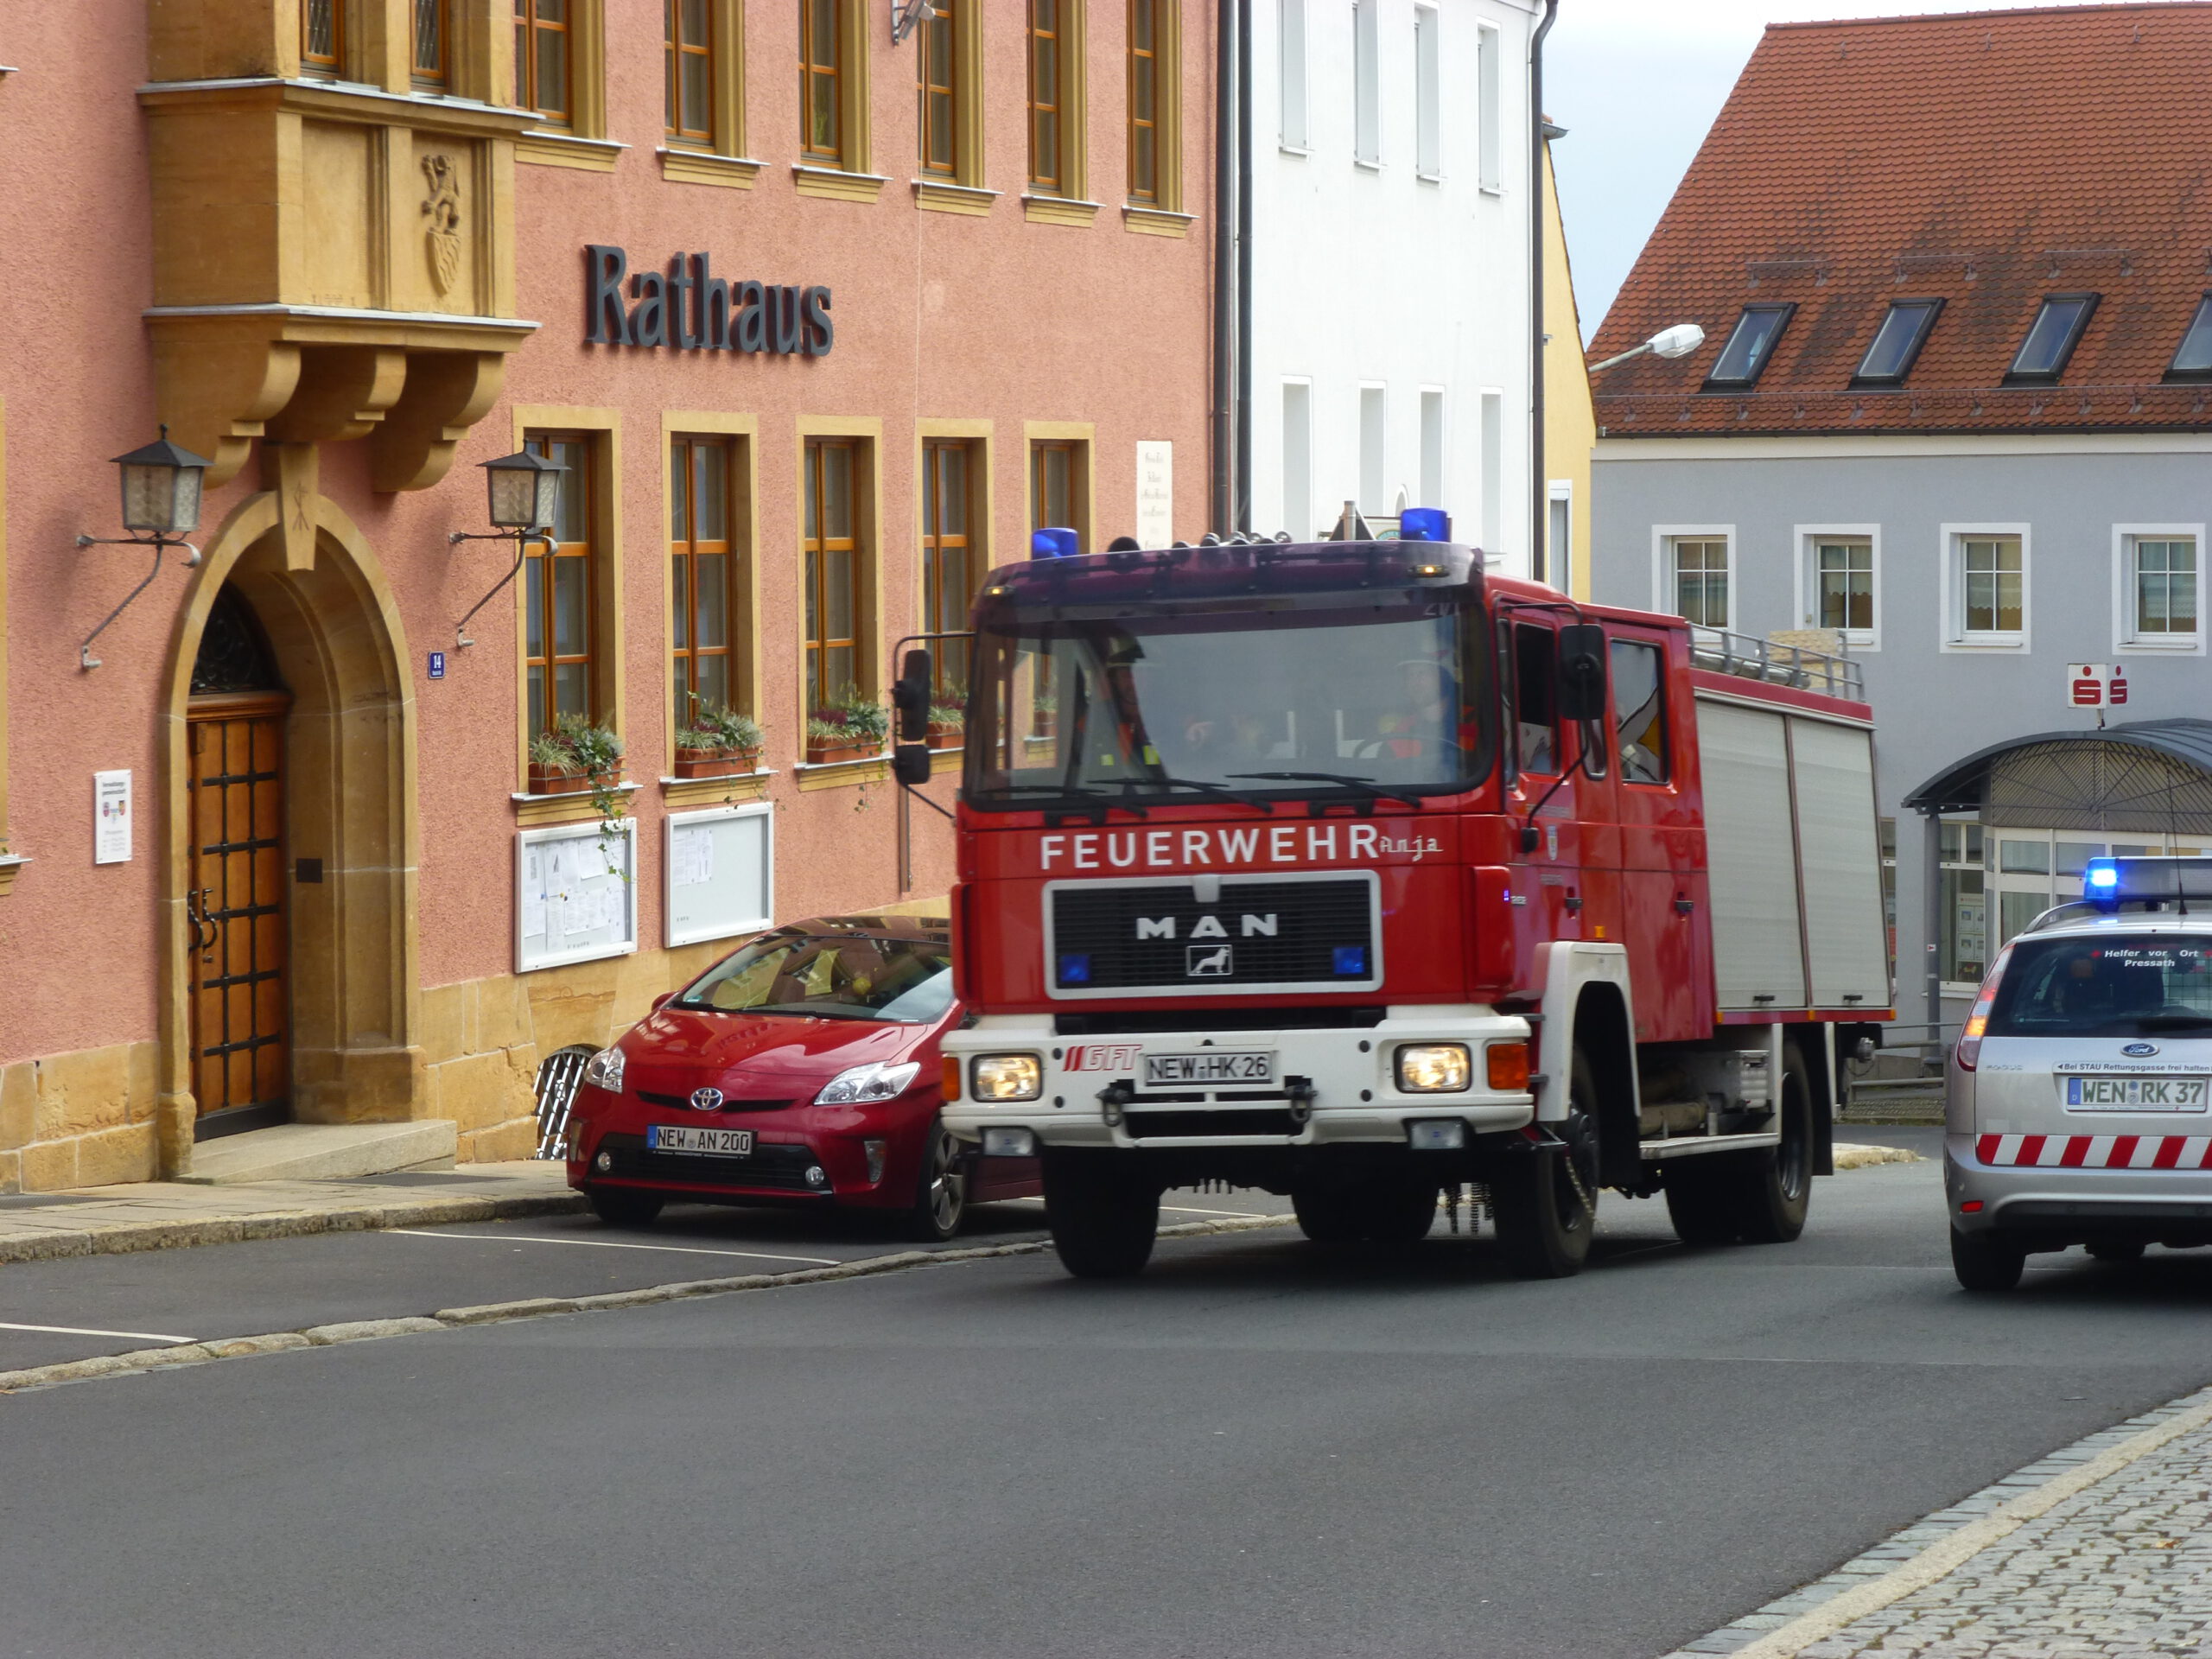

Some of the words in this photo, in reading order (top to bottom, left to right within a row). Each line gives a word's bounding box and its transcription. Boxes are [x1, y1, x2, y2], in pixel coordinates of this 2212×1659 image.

[583, 245, 834, 356] Rathaus
[434, 655, 442, 669] 14
[1040, 824, 1379, 869] FEUERWEHR
[1380, 835, 1443, 861] Anja
[1136, 913, 1278, 940] MAN
[1243, 1056, 1268, 1077] 26
[2103, 1064, 2165, 1072] Rettungsgasse
[2082, 1081, 2126, 1103] WEN
[2140, 1082, 2171, 1103] RK
[2174, 1083, 2203, 1104] 37
[657, 1128, 686, 1147] NEW
[697, 1131, 717, 1150] AN
[721, 1133, 749, 1152] 200
